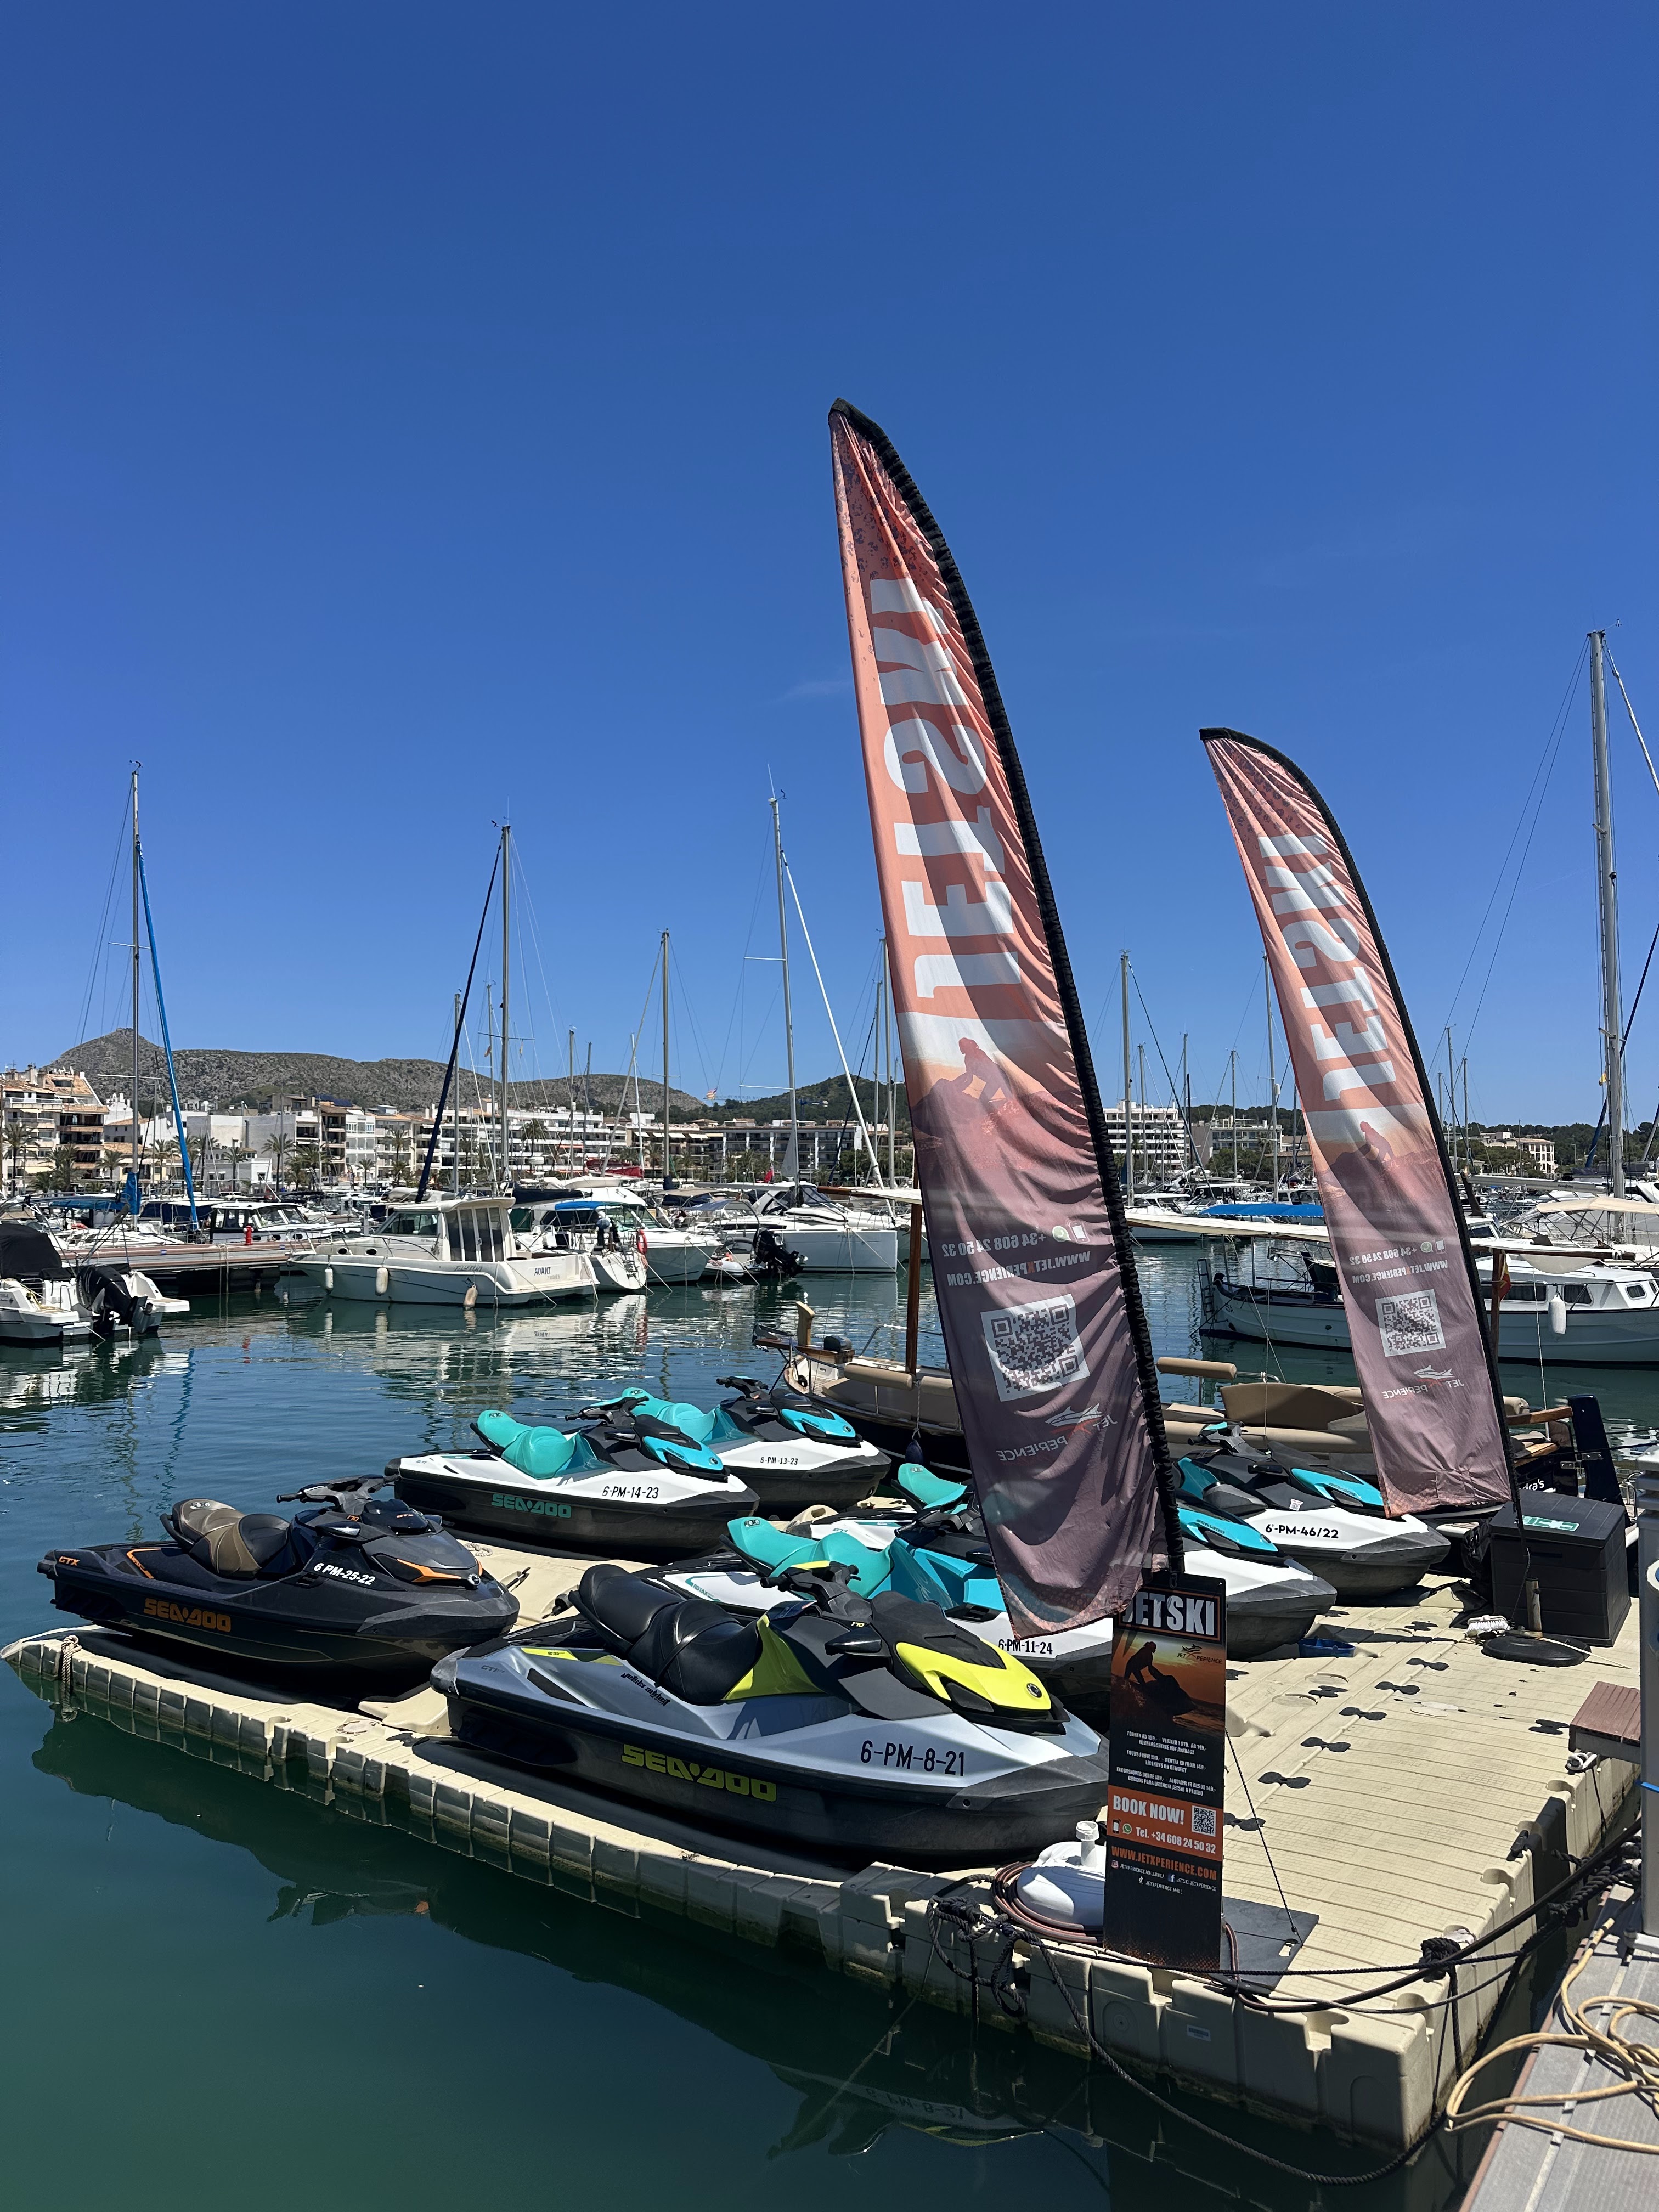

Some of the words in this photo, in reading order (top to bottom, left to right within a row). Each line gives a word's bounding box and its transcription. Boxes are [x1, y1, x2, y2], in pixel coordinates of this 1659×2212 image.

[760, 1457, 798, 1465] 6-PM-13-23
[602, 1486, 659, 1499] 6-PM-14-23
[59, 1556, 80, 1566] GTX
[314, 1562, 325, 1571] 6
[322, 1565, 376, 1585] PM-25-22
[1122, 1591, 1215, 1636] JETSKI
[998, 1638, 1053, 1655] 6-PM-11-24
[860, 1740, 964, 1776] 6-PM-8-21
[1193, 1782, 1205, 1791] DESDE
[1113, 1795, 1147, 1817] BOOK
[1150, 1803, 1185, 1825] NOW!
[1136, 1826, 1149, 1839] Tel.
[1151, 1831, 1166, 1843] +34
[1166, 1833, 1182, 1846] 608
[1183, 1838, 1193, 1849] 24
[1194, 1840, 1204, 1852] 50
[1205, 1843, 1216, 1854] 32
[1111, 1846, 1217, 1881] WWW.JETXPERIENCE.COM
